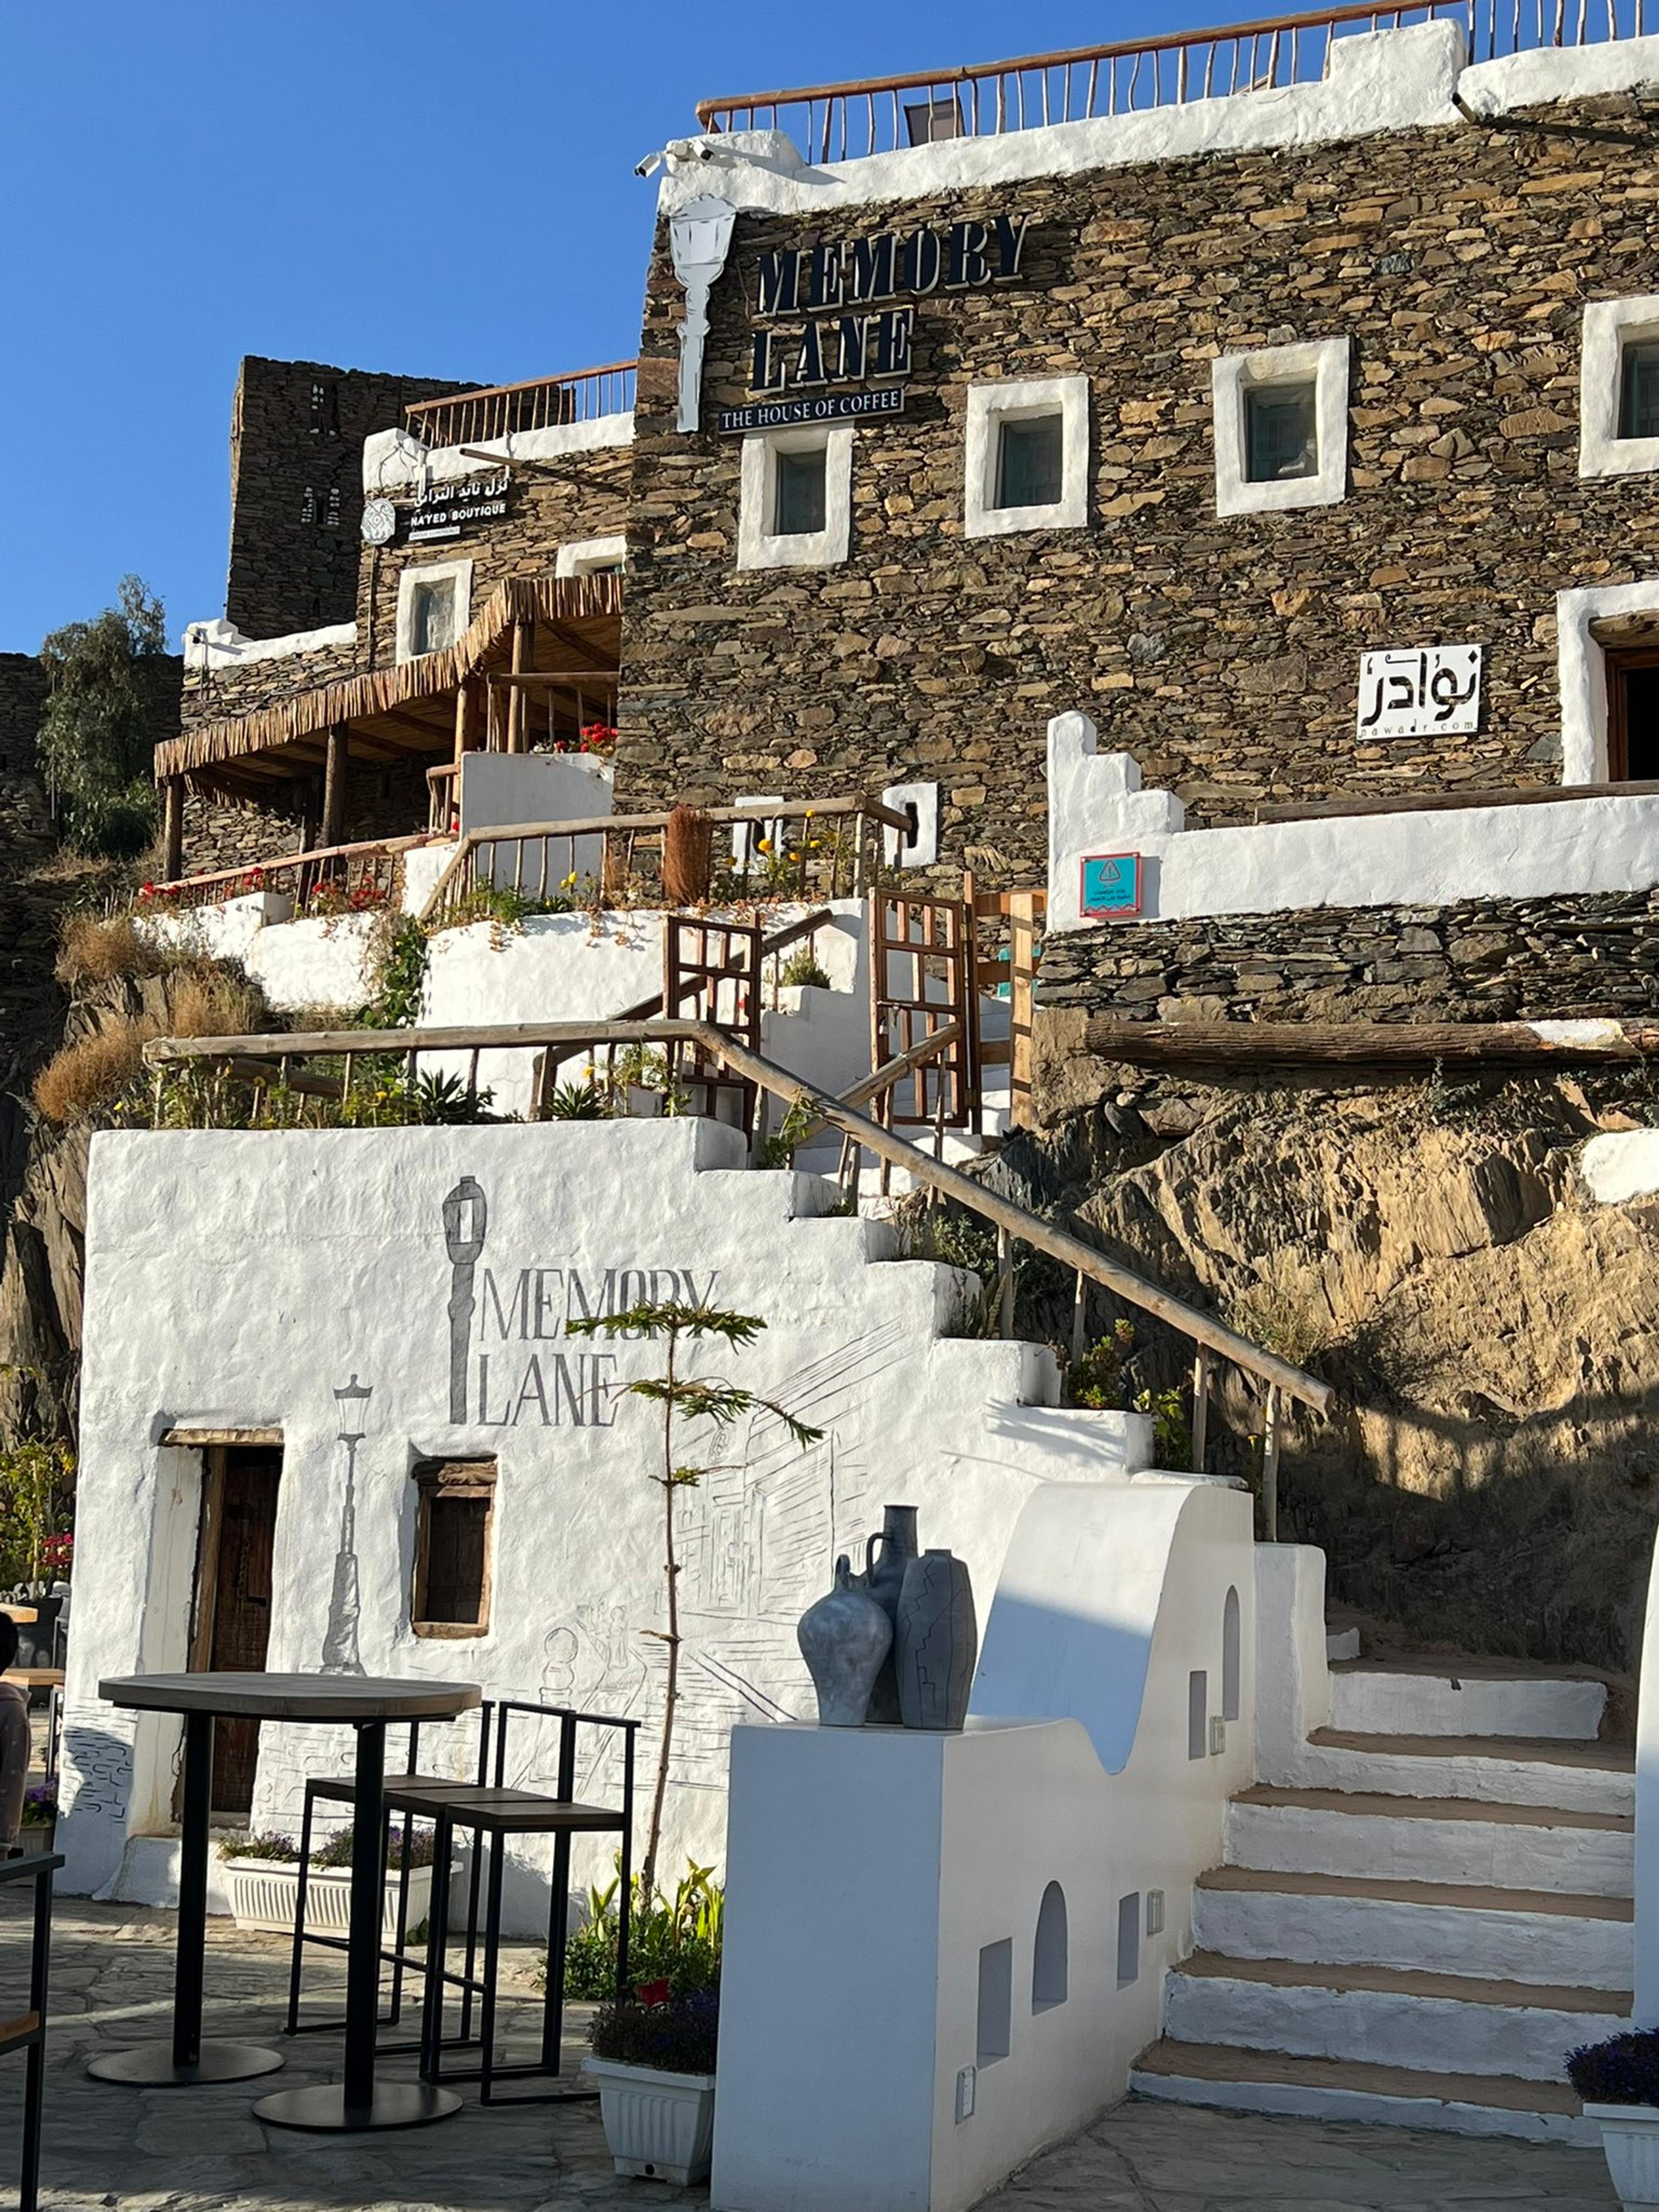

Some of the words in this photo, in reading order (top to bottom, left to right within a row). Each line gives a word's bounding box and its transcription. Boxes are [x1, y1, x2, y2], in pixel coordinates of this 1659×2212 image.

[752, 215, 1027, 318] MEMORY
[748, 307, 913, 397] LANE
[722, 410, 753, 428] THE
[757, 402, 810, 424] HOUSE
[815, 399, 835, 417] OF
[839, 390, 899, 413] COFFEE
[410, 512, 447, 527] NAYED
[452, 503, 506, 521] BOUTIQUE
[480, 1268, 721, 1342] MEMORY
[476, 1353, 619, 1427] LANE
